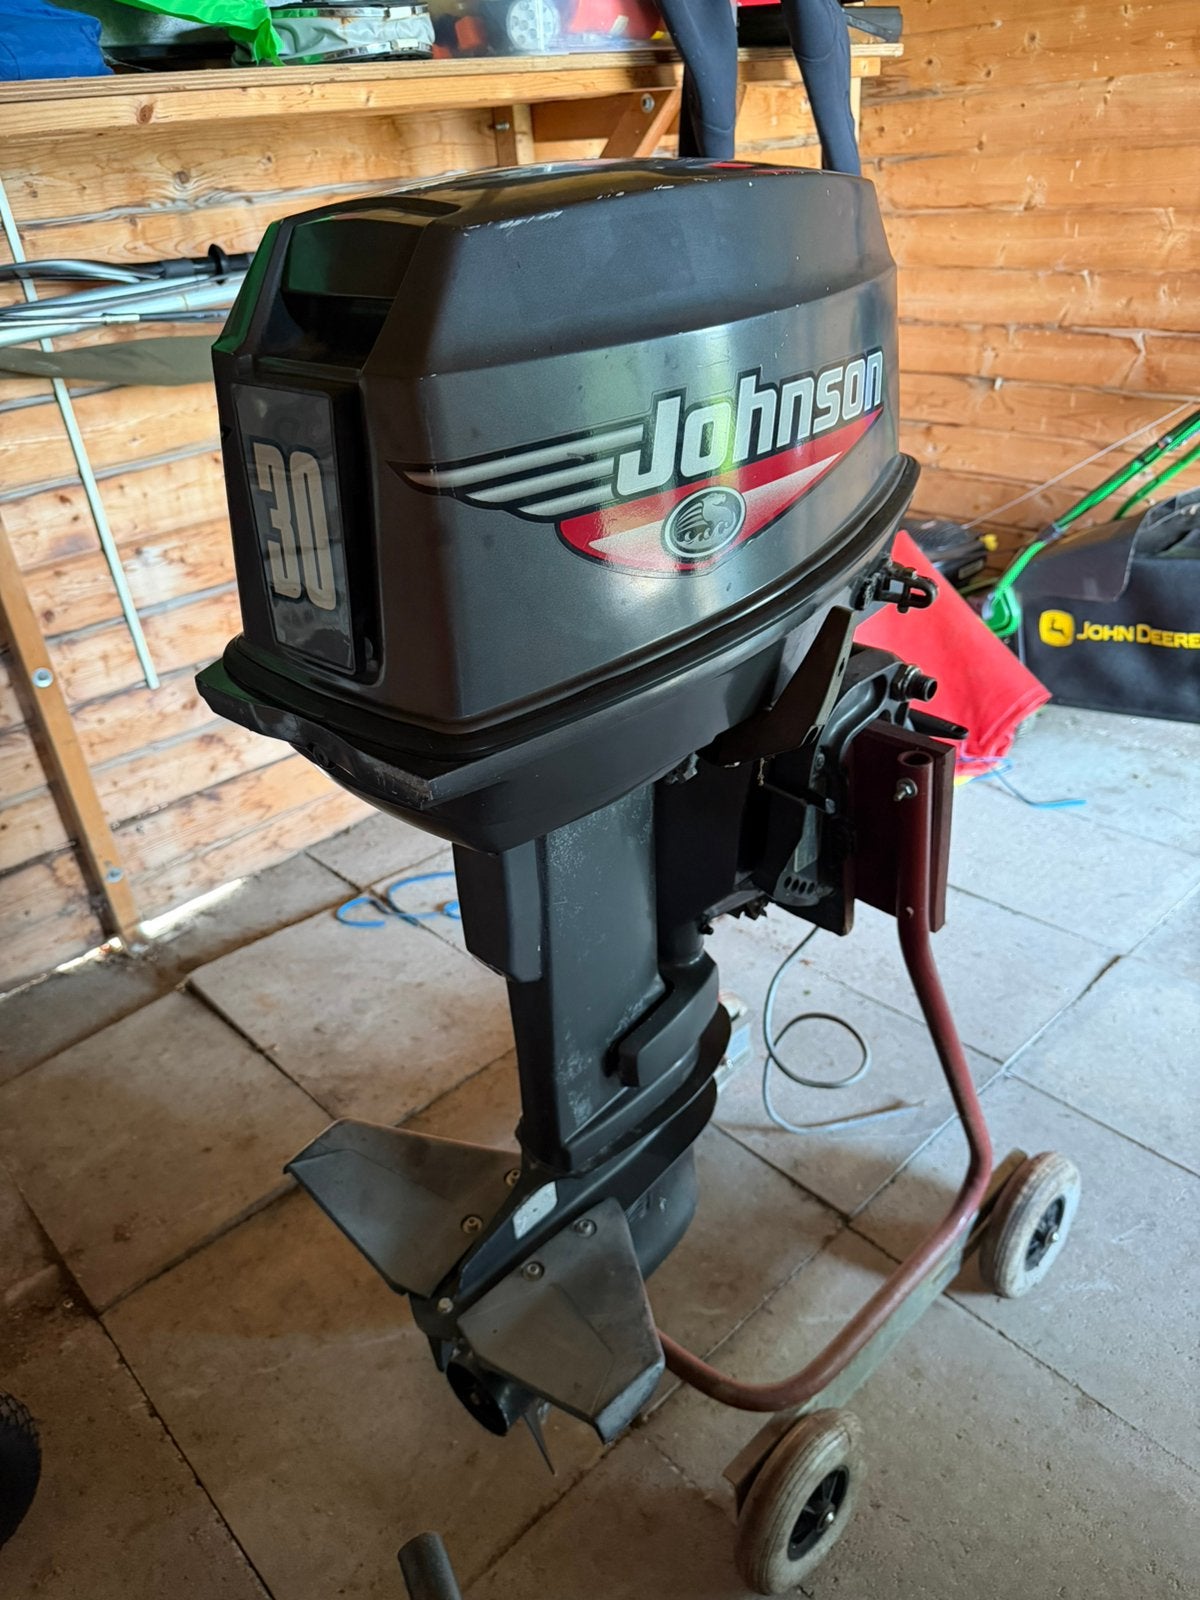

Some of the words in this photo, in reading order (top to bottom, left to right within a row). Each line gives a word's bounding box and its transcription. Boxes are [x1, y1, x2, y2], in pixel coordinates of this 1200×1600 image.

[616, 350, 884, 496] Johnson
[253, 442, 337, 611] 30
[1076, 621, 1135, 642] JOHN
[1136, 623, 1200, 649] DEERE
